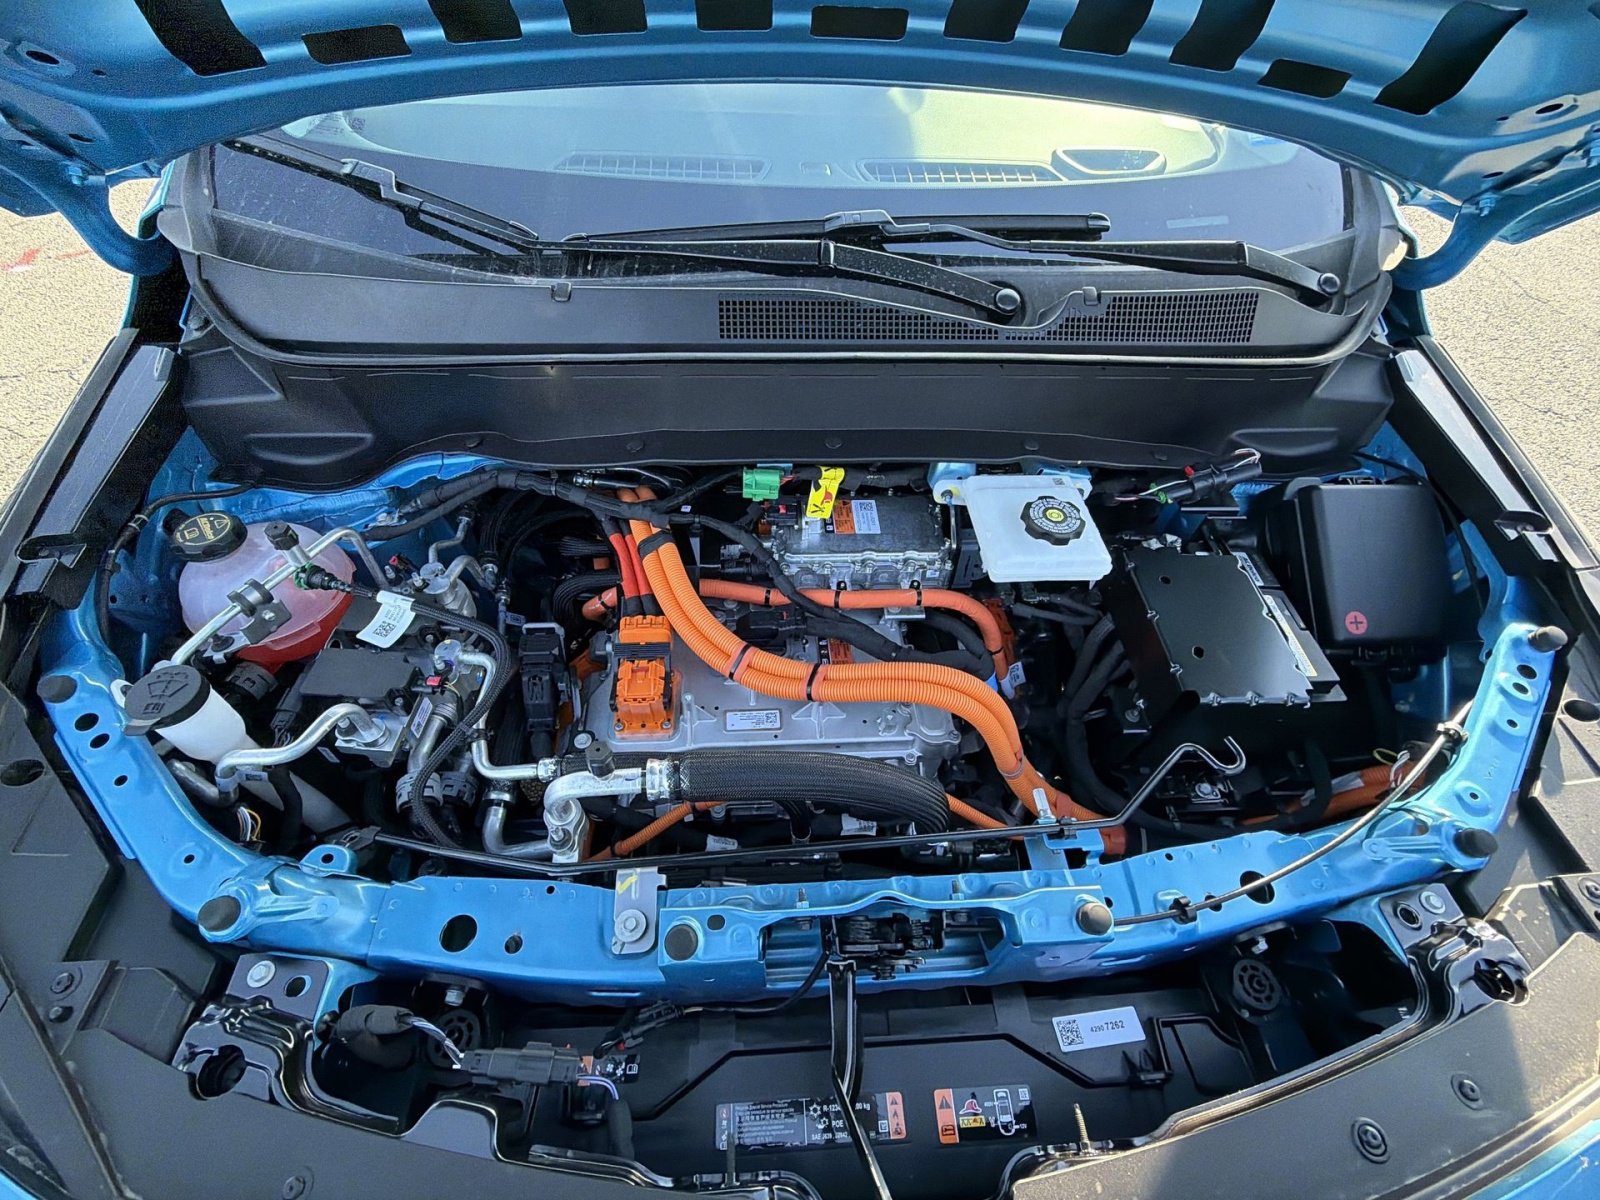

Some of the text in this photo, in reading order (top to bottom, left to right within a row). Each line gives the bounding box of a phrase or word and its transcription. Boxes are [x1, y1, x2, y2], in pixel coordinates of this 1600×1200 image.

[1104, 1020, 1126, 1031] 7262
[863, 1102, 871, 1111] kg
[831, 1120, 844, 1128] POE
